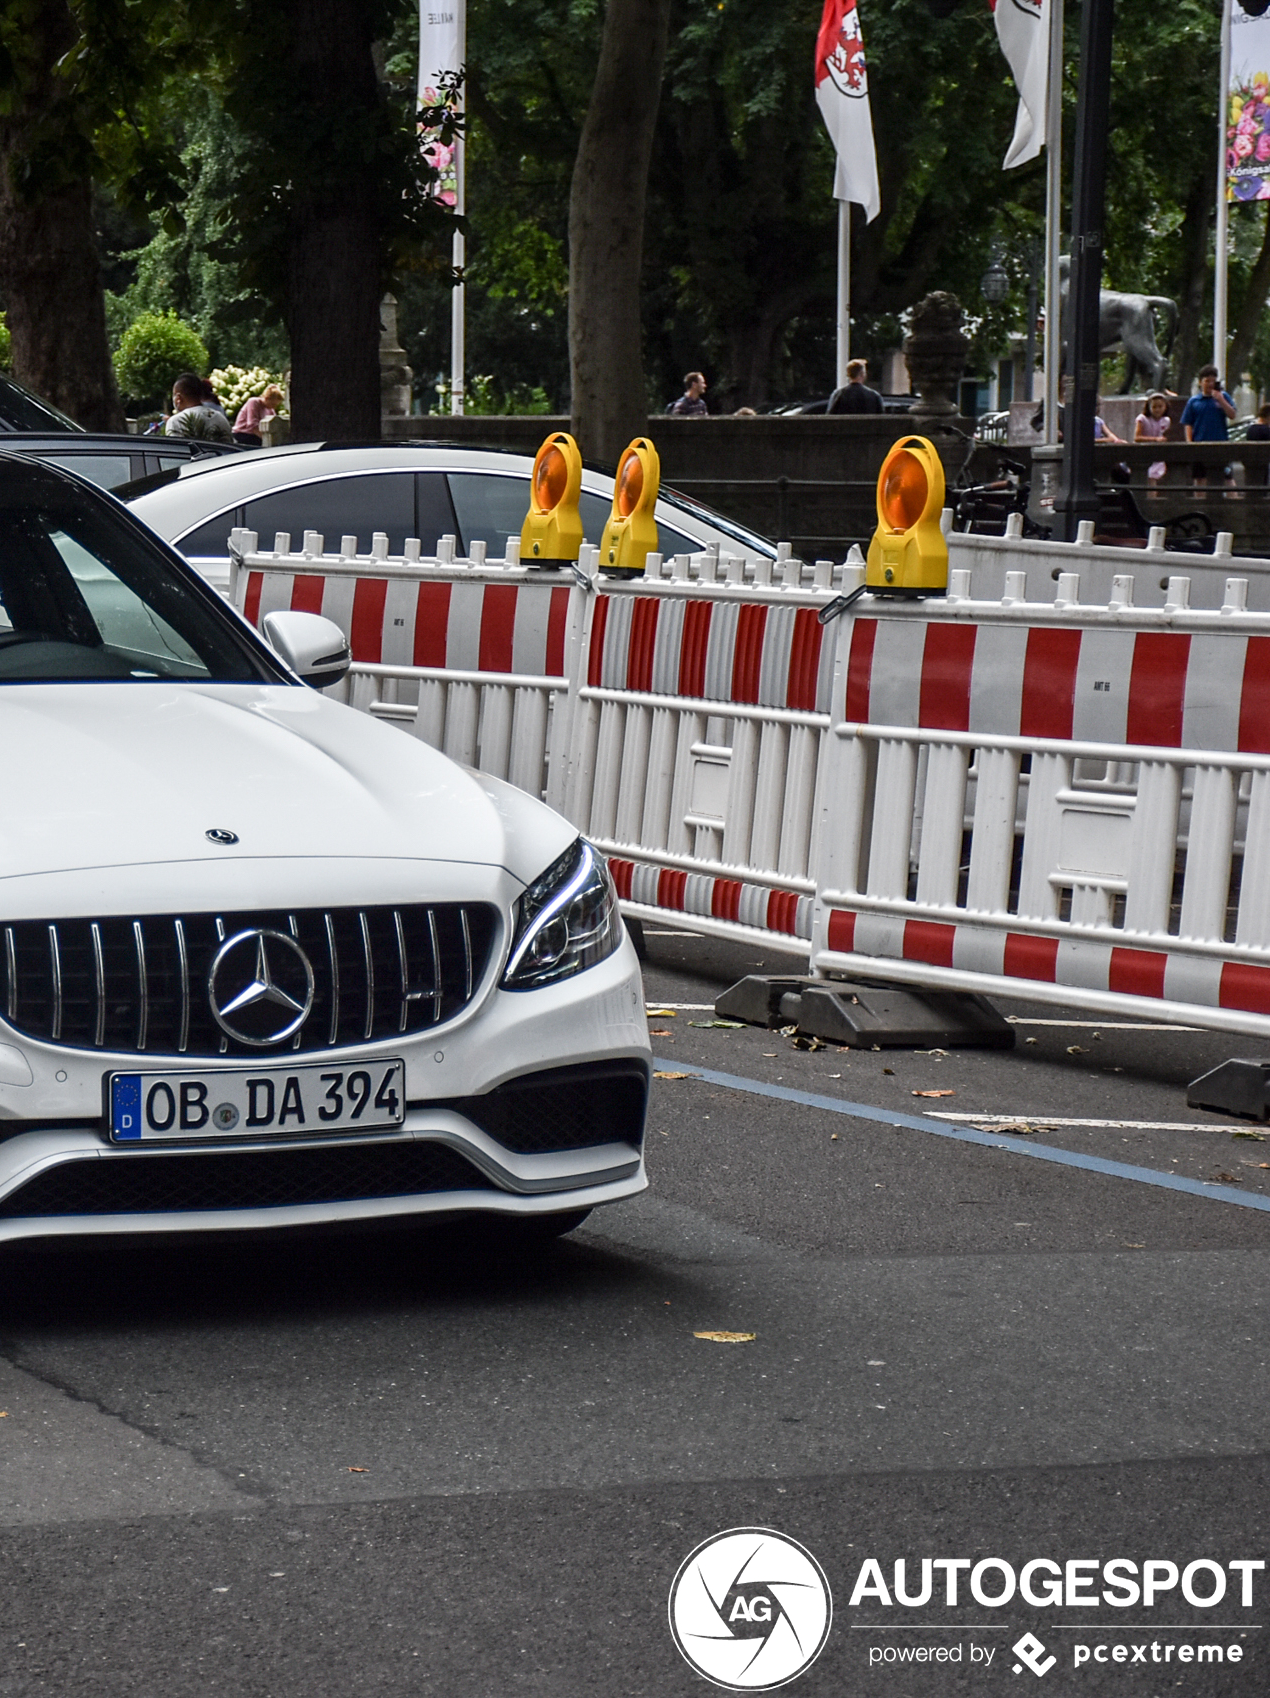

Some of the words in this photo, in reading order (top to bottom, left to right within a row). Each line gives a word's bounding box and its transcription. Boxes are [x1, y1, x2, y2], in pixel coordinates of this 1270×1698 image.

[146, 1081, 209, 1131] OB
[246, 1076, 305, 1126] DA
[318, 1068, 399, 1121] 394
[122, 1115, 133, 1129] D
